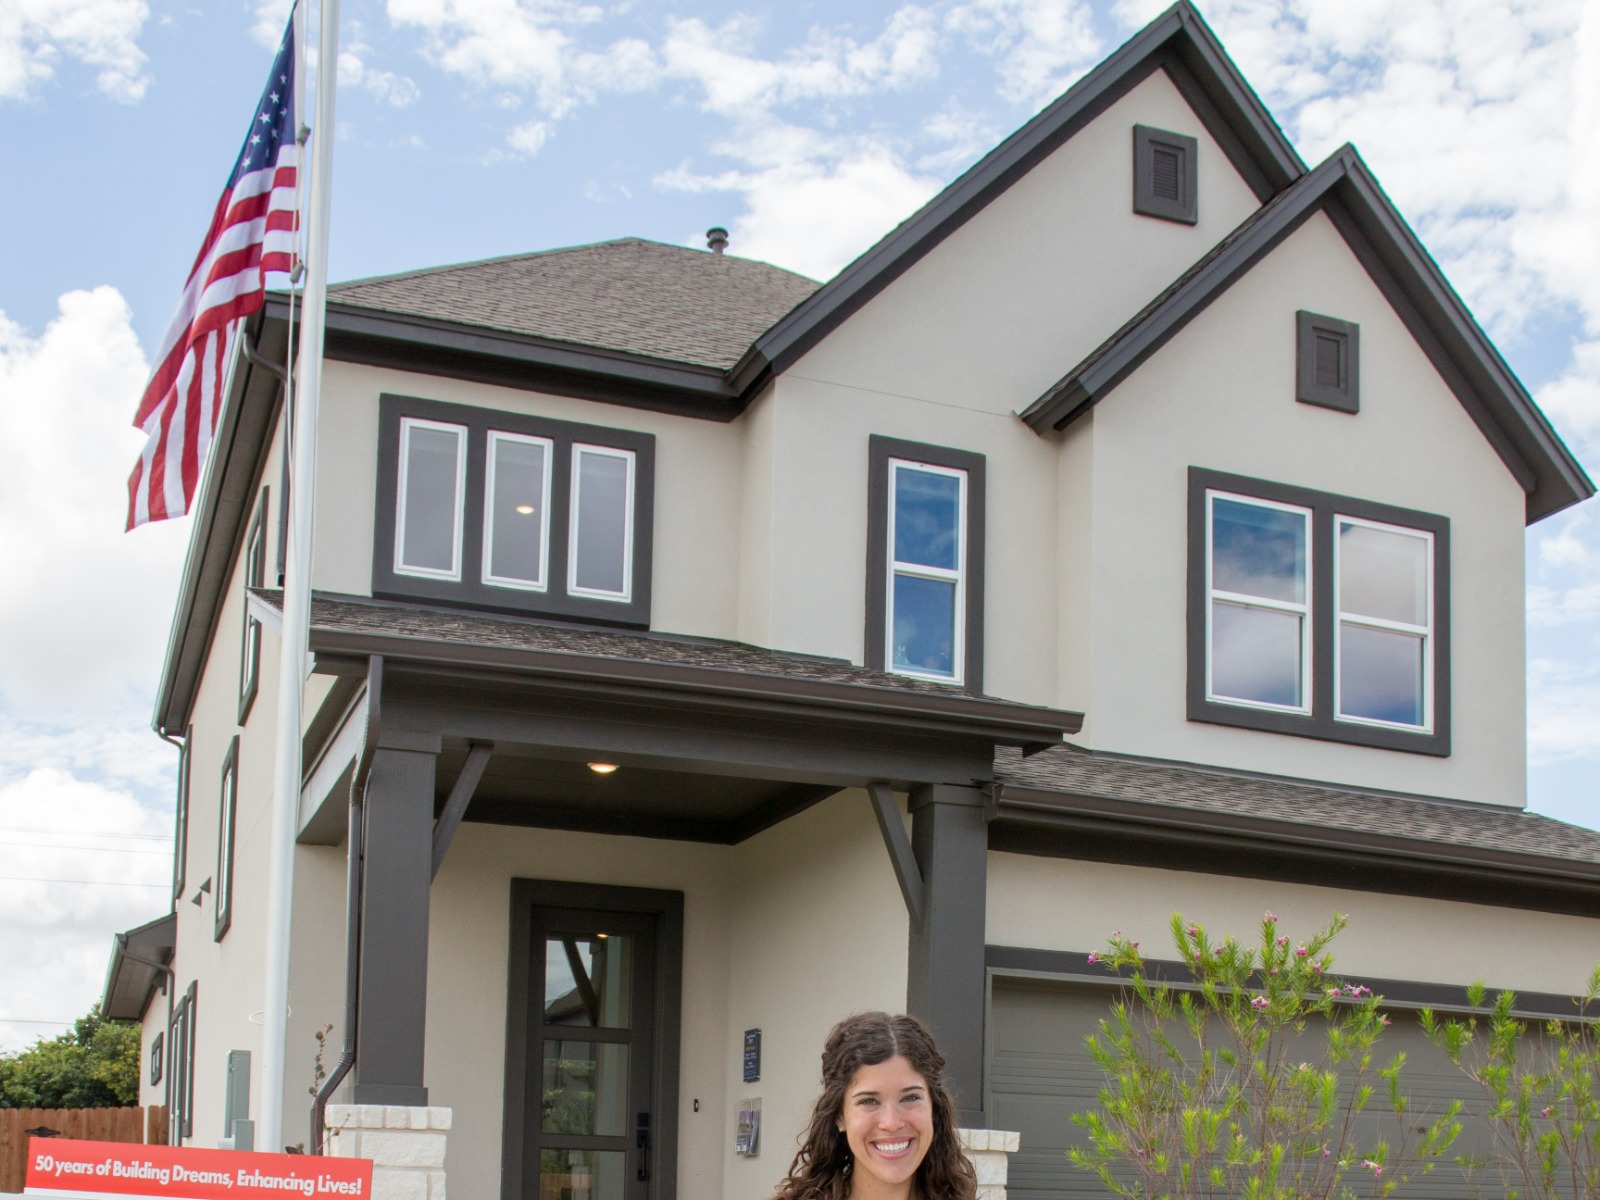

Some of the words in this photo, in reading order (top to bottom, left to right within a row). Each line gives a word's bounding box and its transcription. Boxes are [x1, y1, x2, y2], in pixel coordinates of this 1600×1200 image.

[35, 1154, 54, 1172] 50
[55, 1160, 94, 1177] years
[95, 1158, 112, 1176] of
[112, 1160, 170, 1185] Building
[172, 1164, 234, 1189] Dreams,
[237, 1168, 315, 1197] Enhancing
[317, 1174, 363, 1196] Lives!
